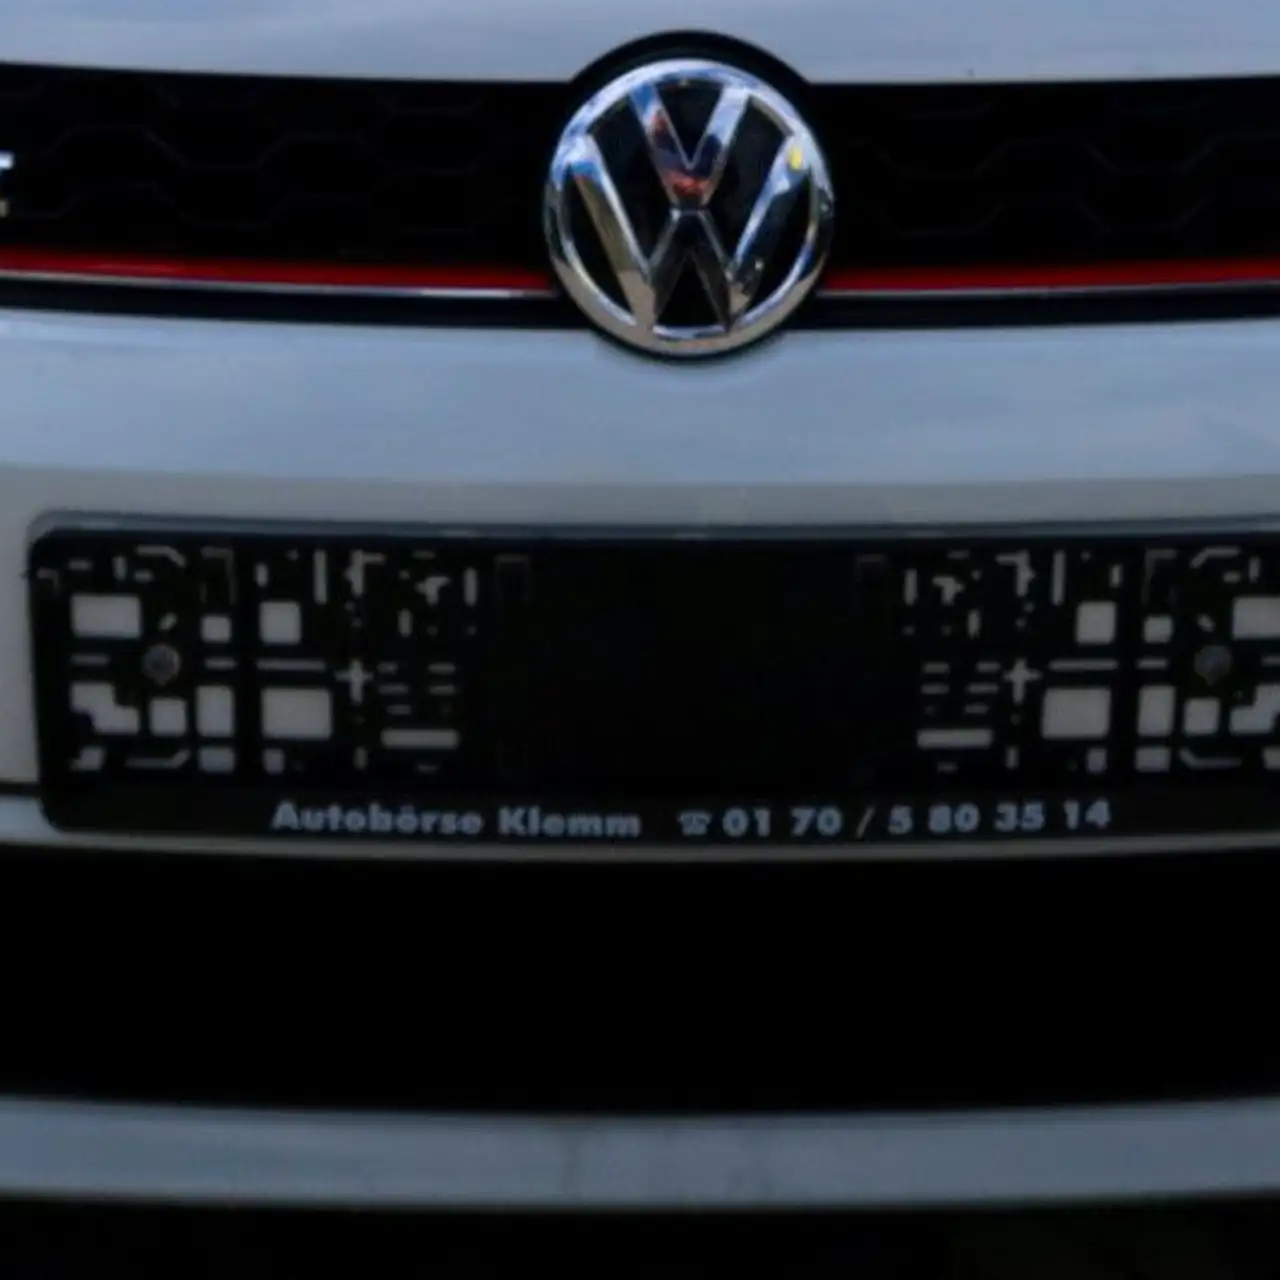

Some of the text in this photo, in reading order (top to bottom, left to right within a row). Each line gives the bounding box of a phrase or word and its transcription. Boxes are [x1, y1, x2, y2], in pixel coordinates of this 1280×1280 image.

[272, 800, 484, 836] Autobörse
[496, 806, 642, 838] Klemm
[721, 807, 771, 838] 01
[791, 806, 845, 837] 70
[886, 805, 914, 837] 5
[927, 803, 980, 835] 80
[993, 801, 1046, 833] 35
[1063, 799, 1112, 830] 14
